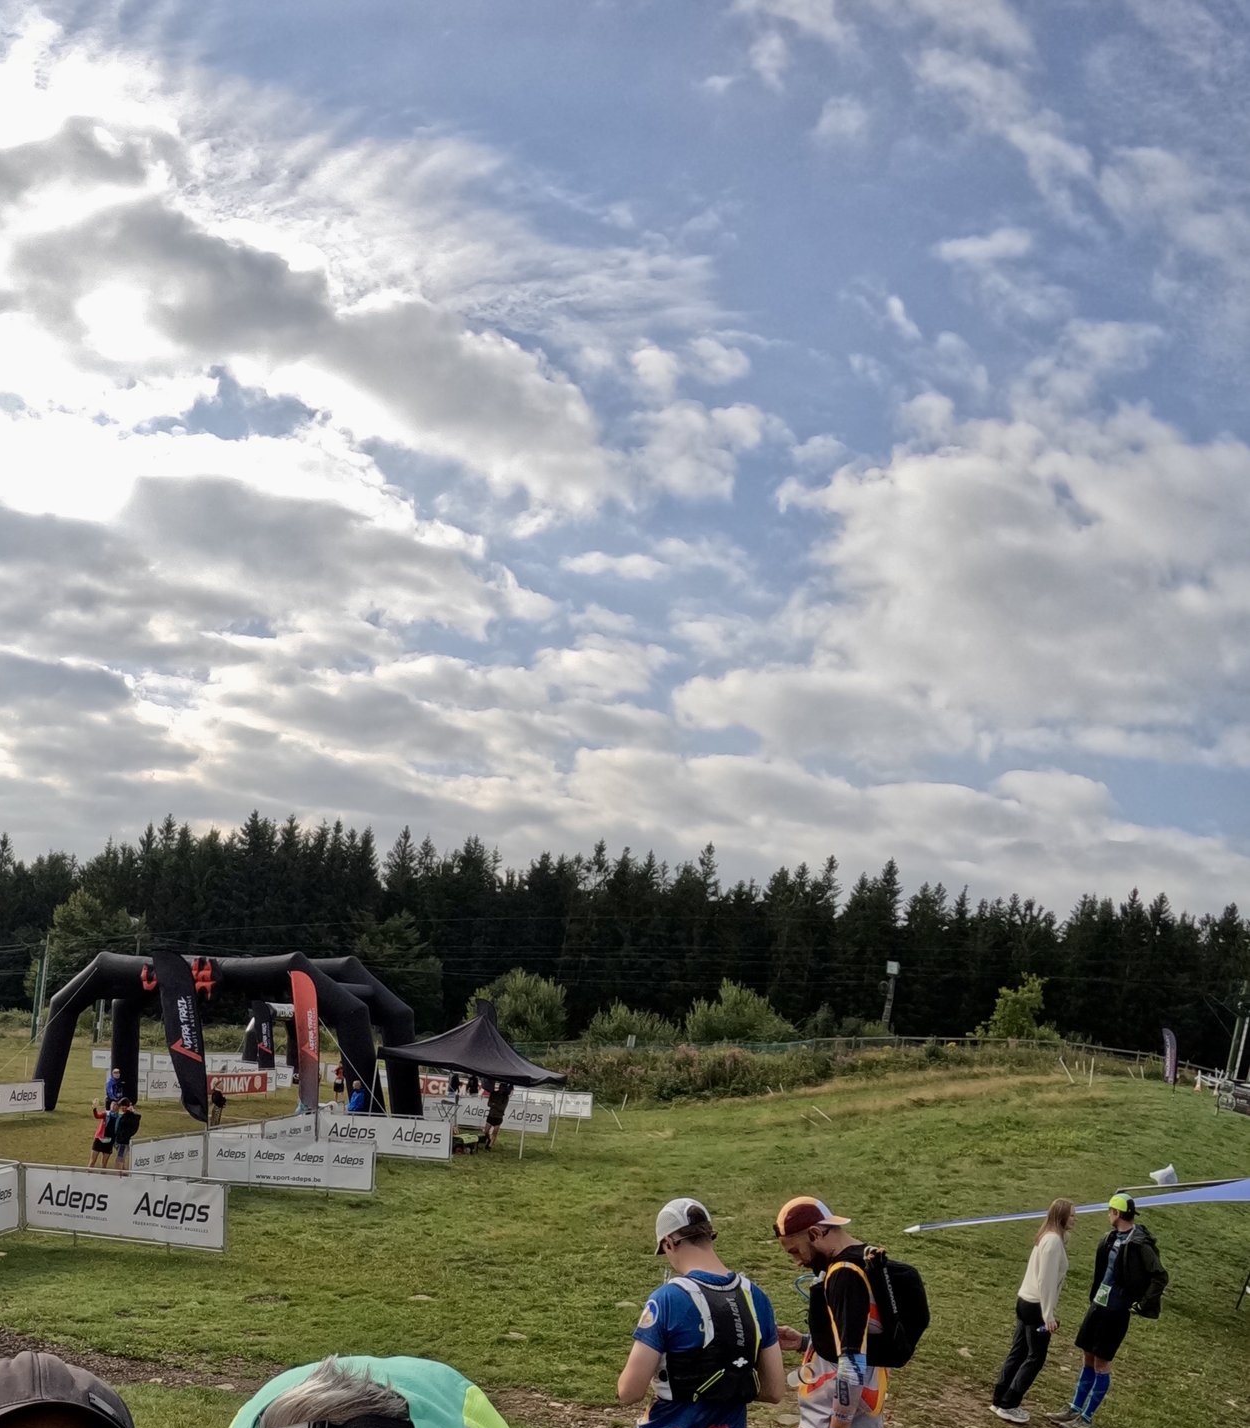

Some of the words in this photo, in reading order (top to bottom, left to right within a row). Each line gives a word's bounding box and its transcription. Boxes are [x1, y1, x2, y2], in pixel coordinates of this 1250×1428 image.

[9, 1089, 38, 1102] Adeps
[463, 1105, 490, 1118] Adep
[329, 1122, 376, 1139] Adeps
[392, 1126, 442, 1145] Adeps
[216, 1148, 246, 1159] Adeps
[254, 1150, 285, 1161] Adeps
[293, 1151, 324, 1164] Adeps
[332, 1154, 364, 1166] Adeps
[255, 1173, 321, 1183] www.sport-adeps.be
[37, 1182, 109, 1213] Adeps
[133, 1191, 210, 1225] Adeps
[883, 1267, 898, 1315] SALOMON
[725, 1297, 745, 1347] RAIDLIGHT
